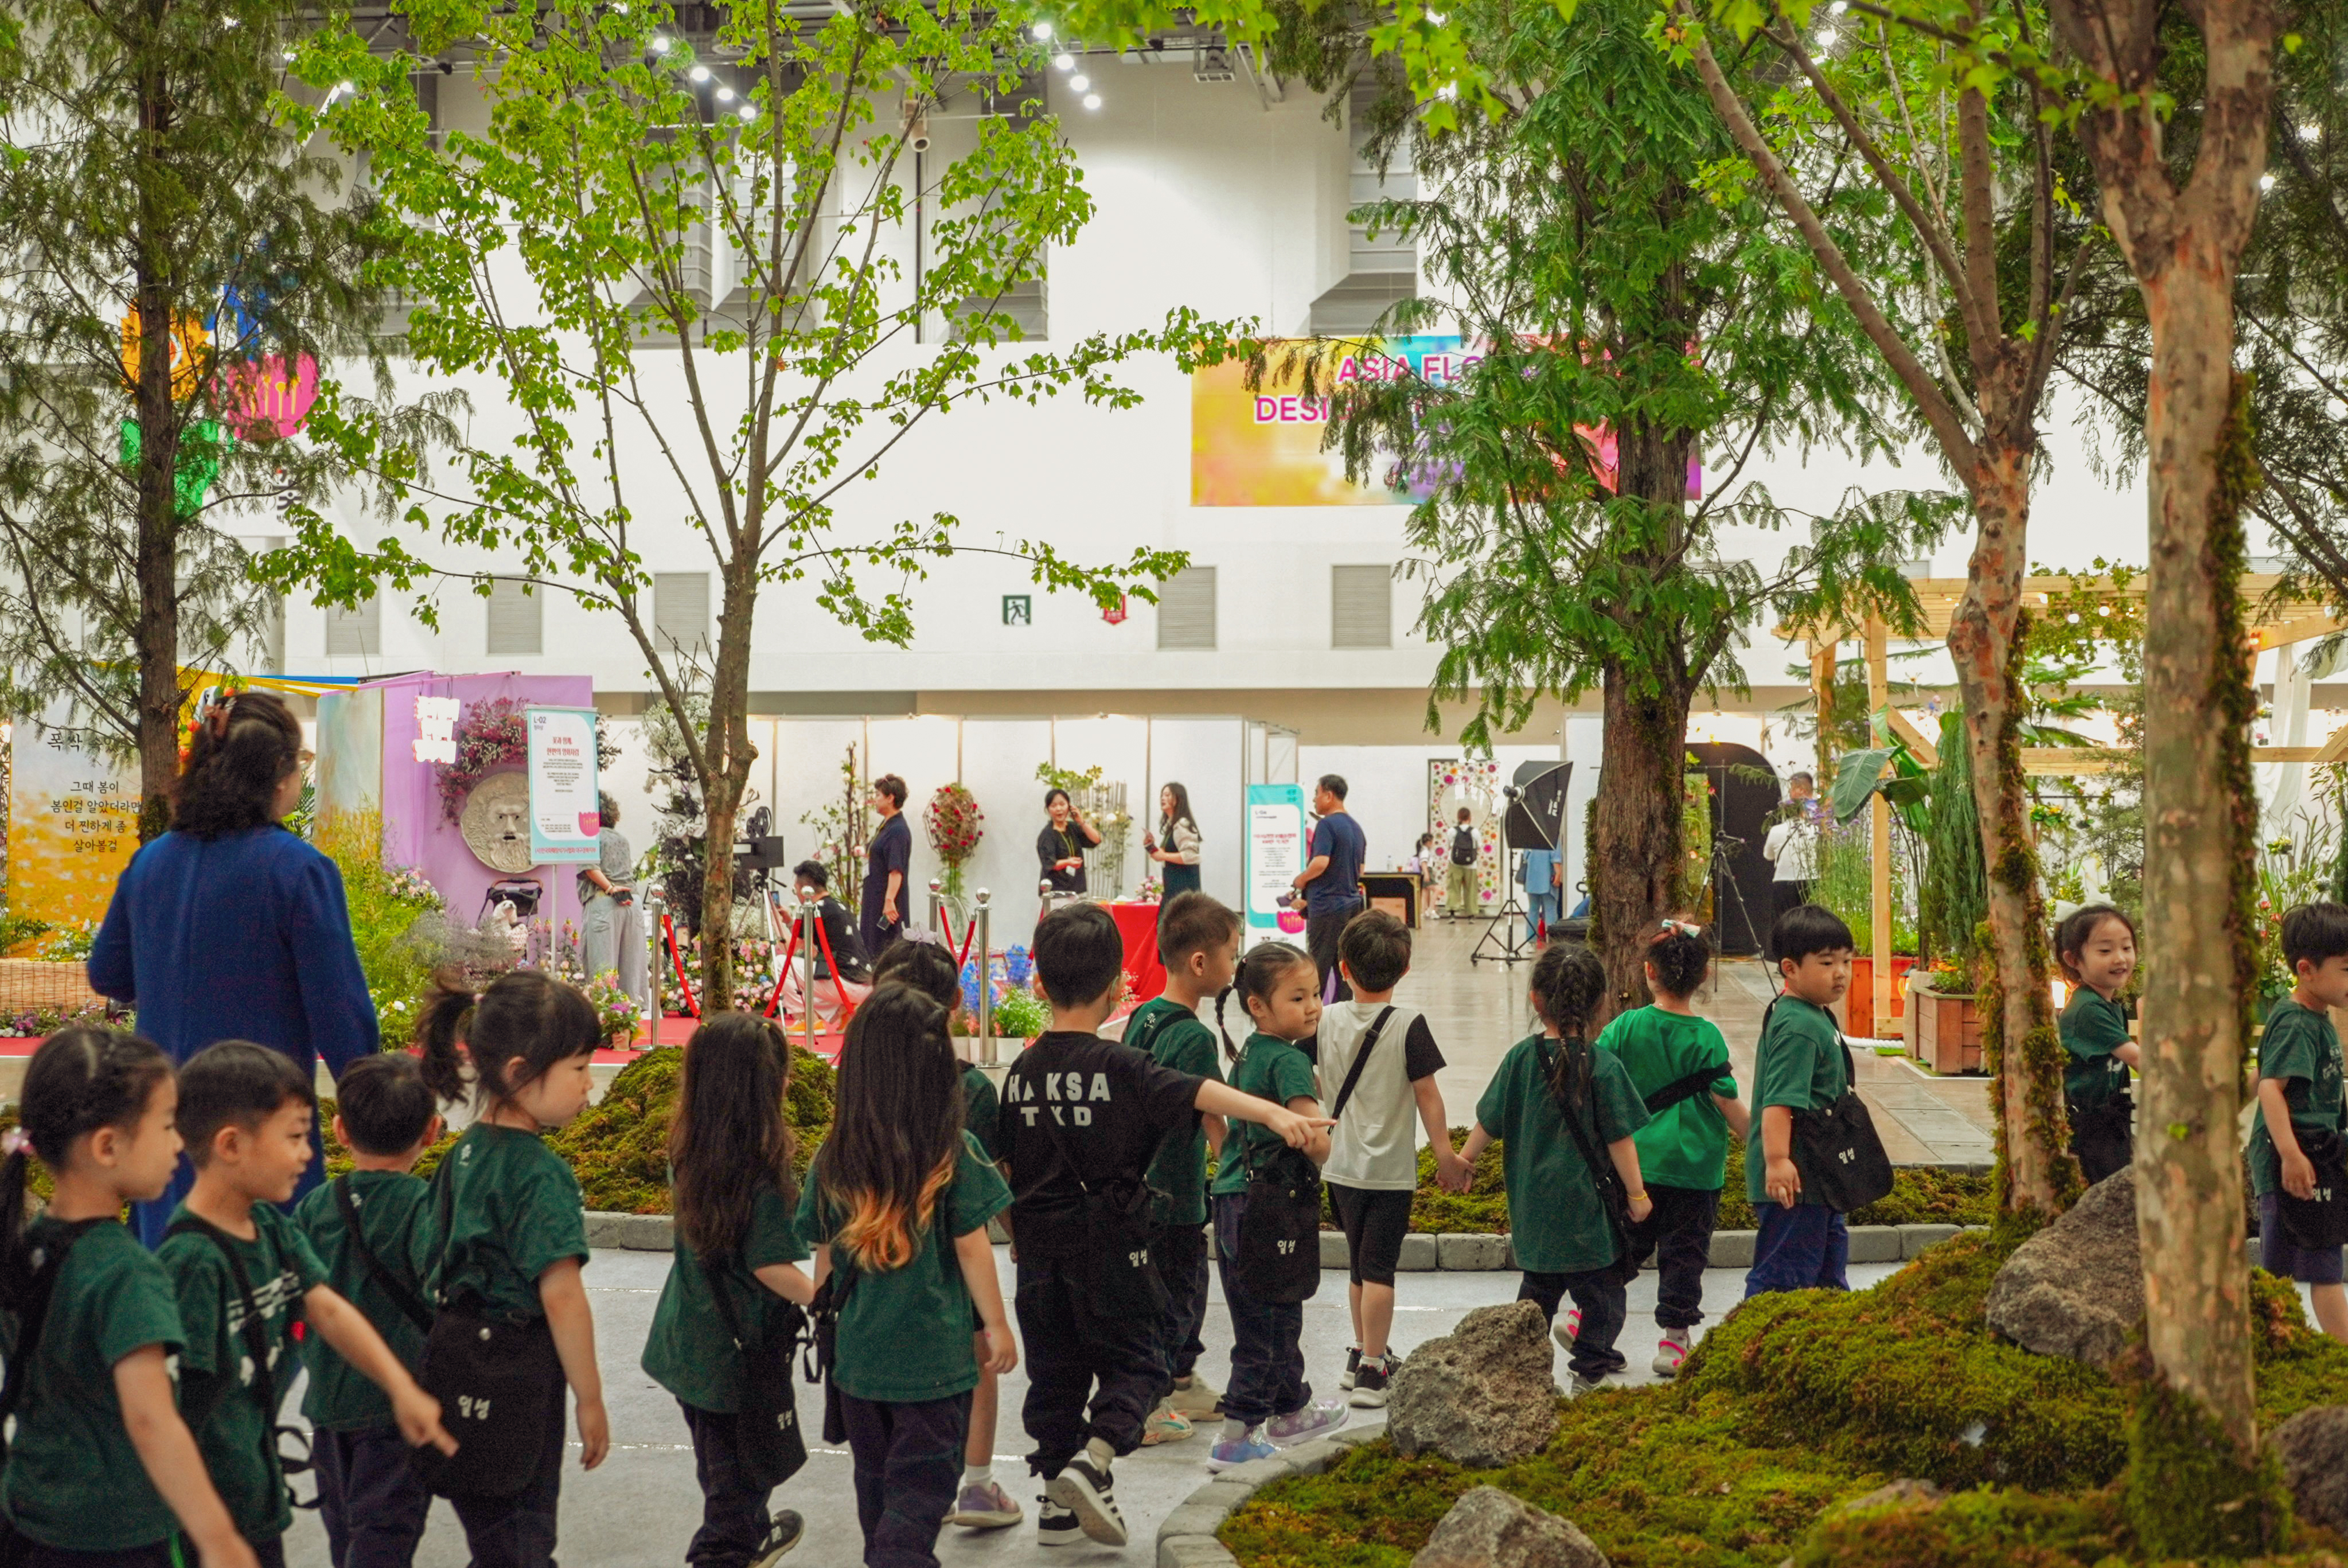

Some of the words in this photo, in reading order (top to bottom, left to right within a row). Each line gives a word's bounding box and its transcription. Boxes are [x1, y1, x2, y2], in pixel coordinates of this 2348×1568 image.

[1339, 357, 1413, 382] ASIA
[533, 716, 547, 724] L-02
[70, 781, 94, 793] 그때
[97, 781, 119, 794] 봄이
[50, 799, 83, 813] 봄인걸
[87, 800, 141, 814] 알았더라면
[65, 820, 75, 832] 더
[79, 820, 112, 833] 찐하게
[116, 821, 127, 833] 좀
[73, 839, 117, 853] 살아볼걸
[1008, 1072, 1111, 1103] HAKSA
[1277, 1239, 1296, 1254] 일성
[1129, 1249, 1147, 1267] 일성
[458, 1395, 490, 1419] 일성
